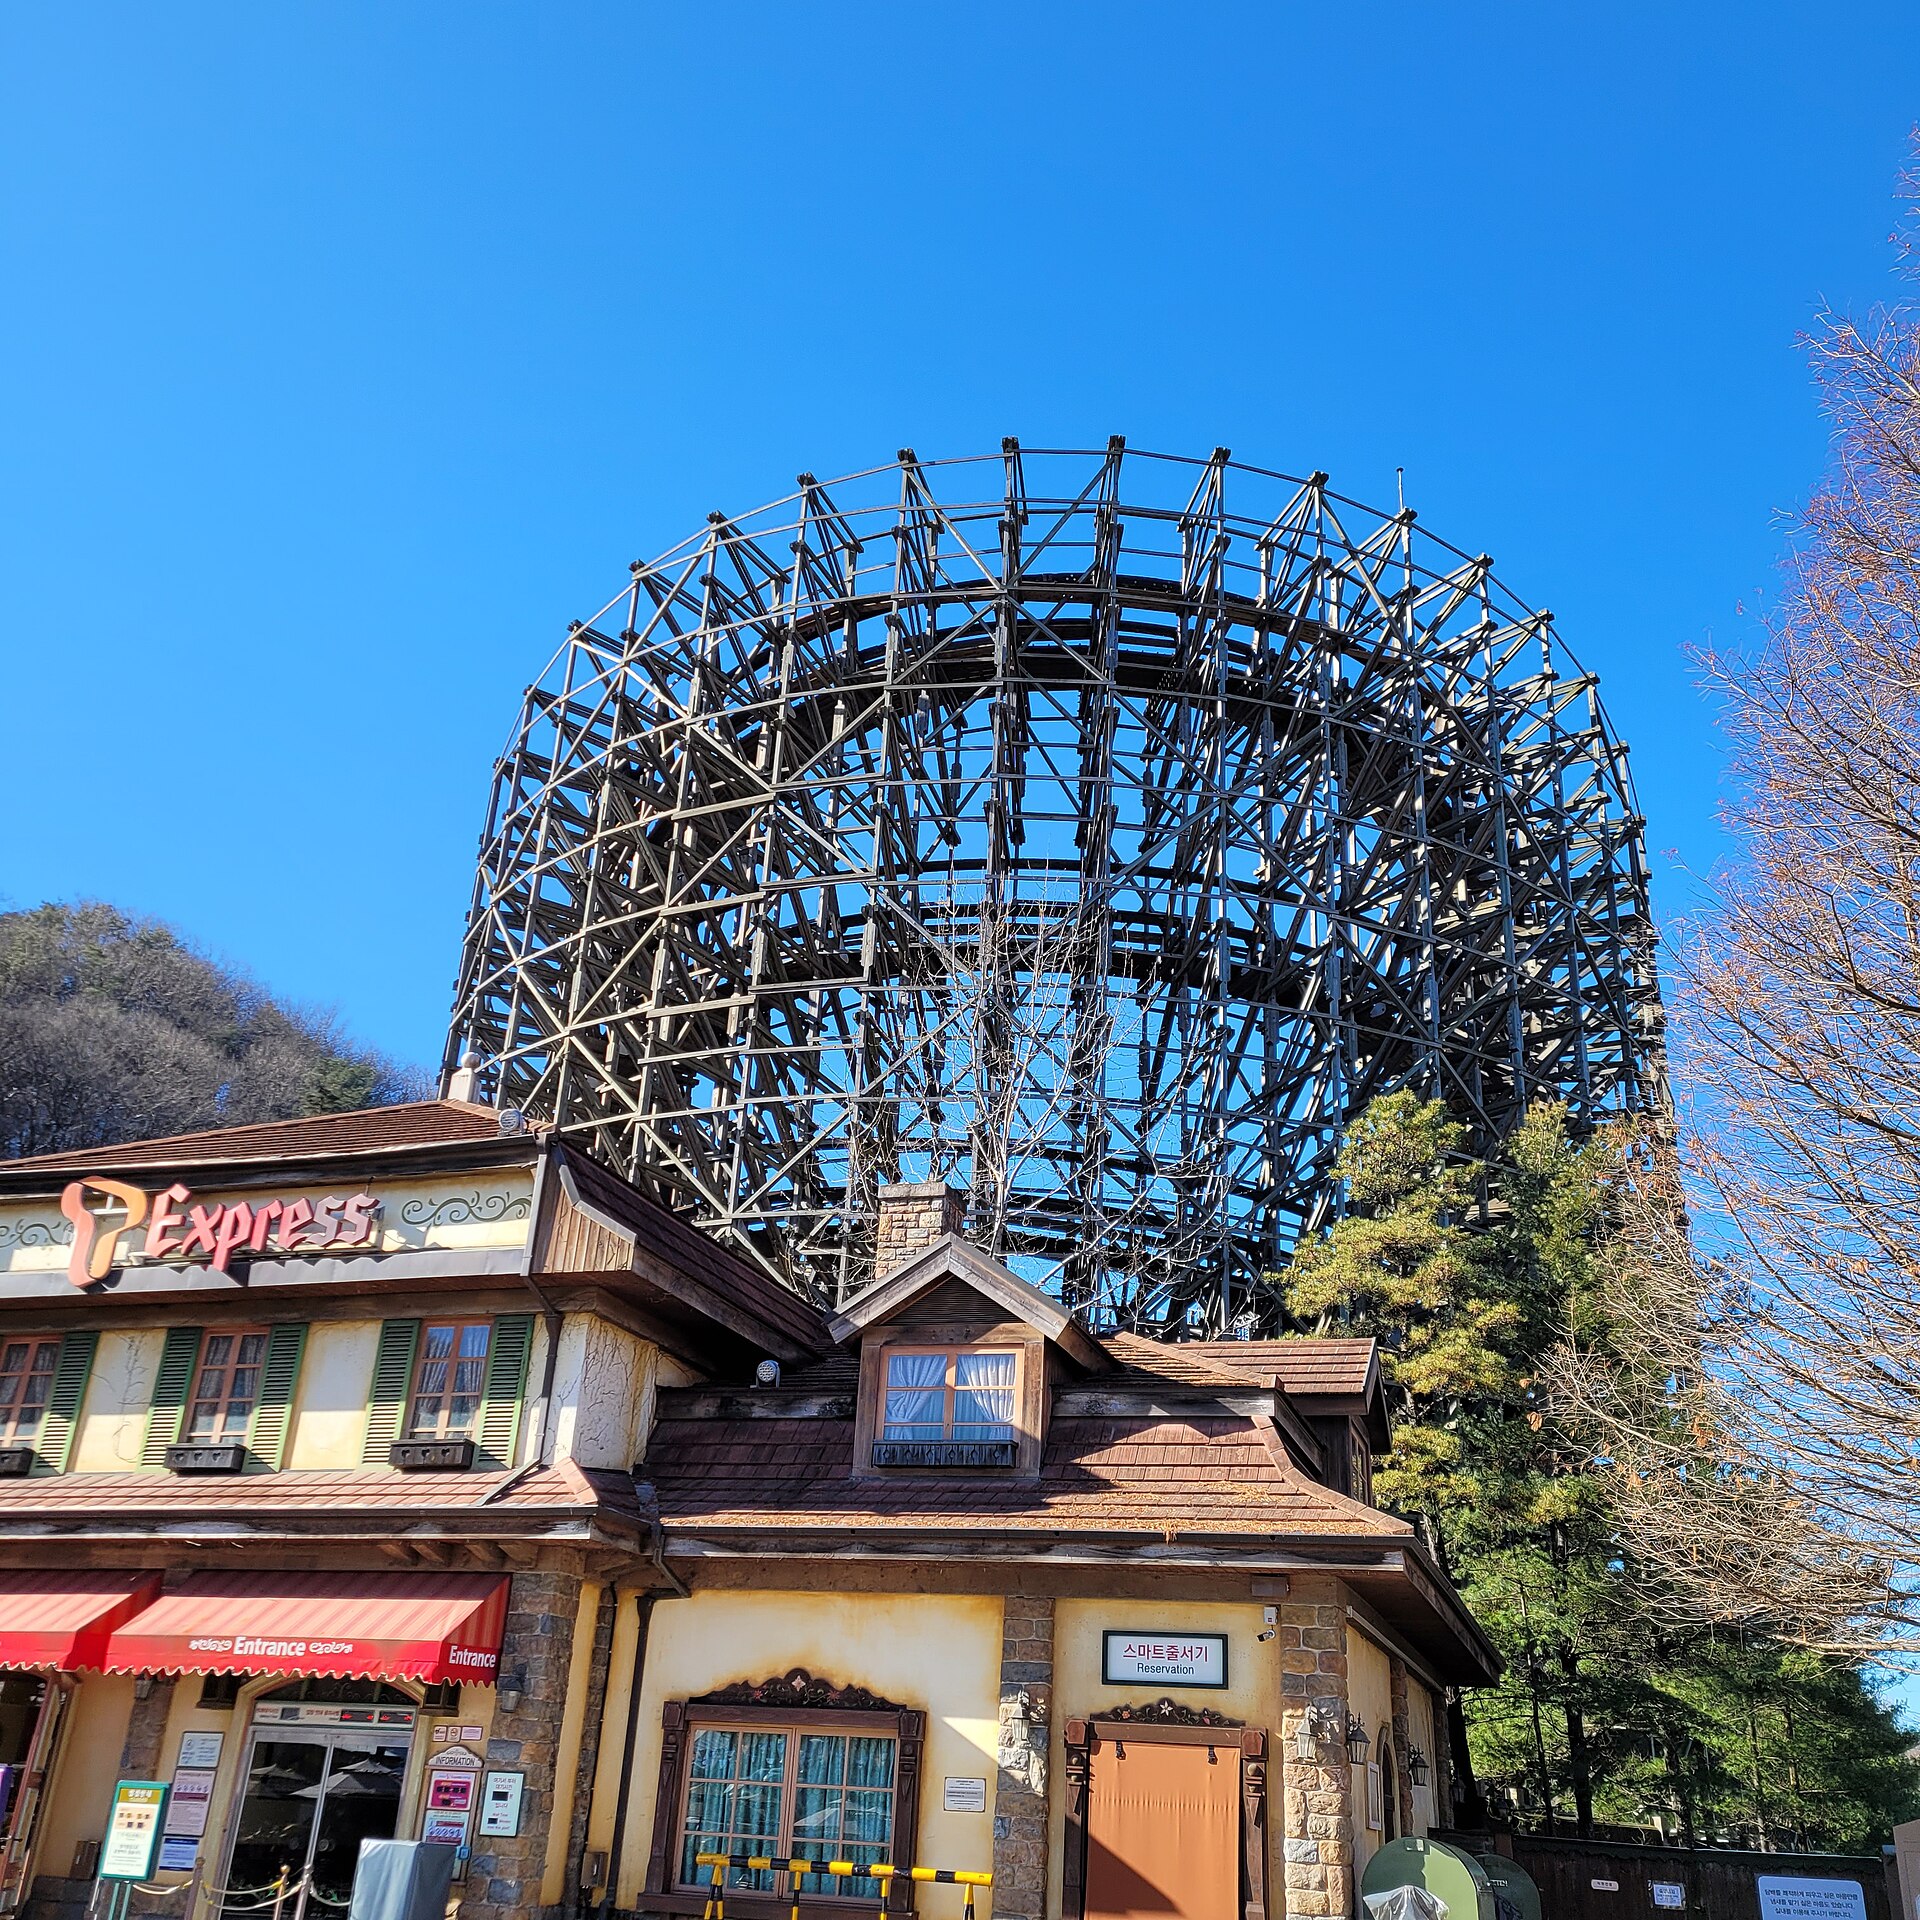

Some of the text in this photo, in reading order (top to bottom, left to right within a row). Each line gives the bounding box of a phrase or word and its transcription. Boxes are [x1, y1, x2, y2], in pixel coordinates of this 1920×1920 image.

[144, 1184, 381, 1272] Express
[234, 1637, 306, 1657] Entrance
[1123, 1643, 1208, 1662] 스마트줄서기
[450, 1645, 496, 1668] Entrance
[1137, 1662, 1195, 1675] Reservation
[436, 1757, 475, 1766] INFORMATION
[1805, 1891, 1822, 1899] 피우고
[1812, 1900, 1830, 1908] 마음도
[1810, 1909, 1828, 1918] 주시기
